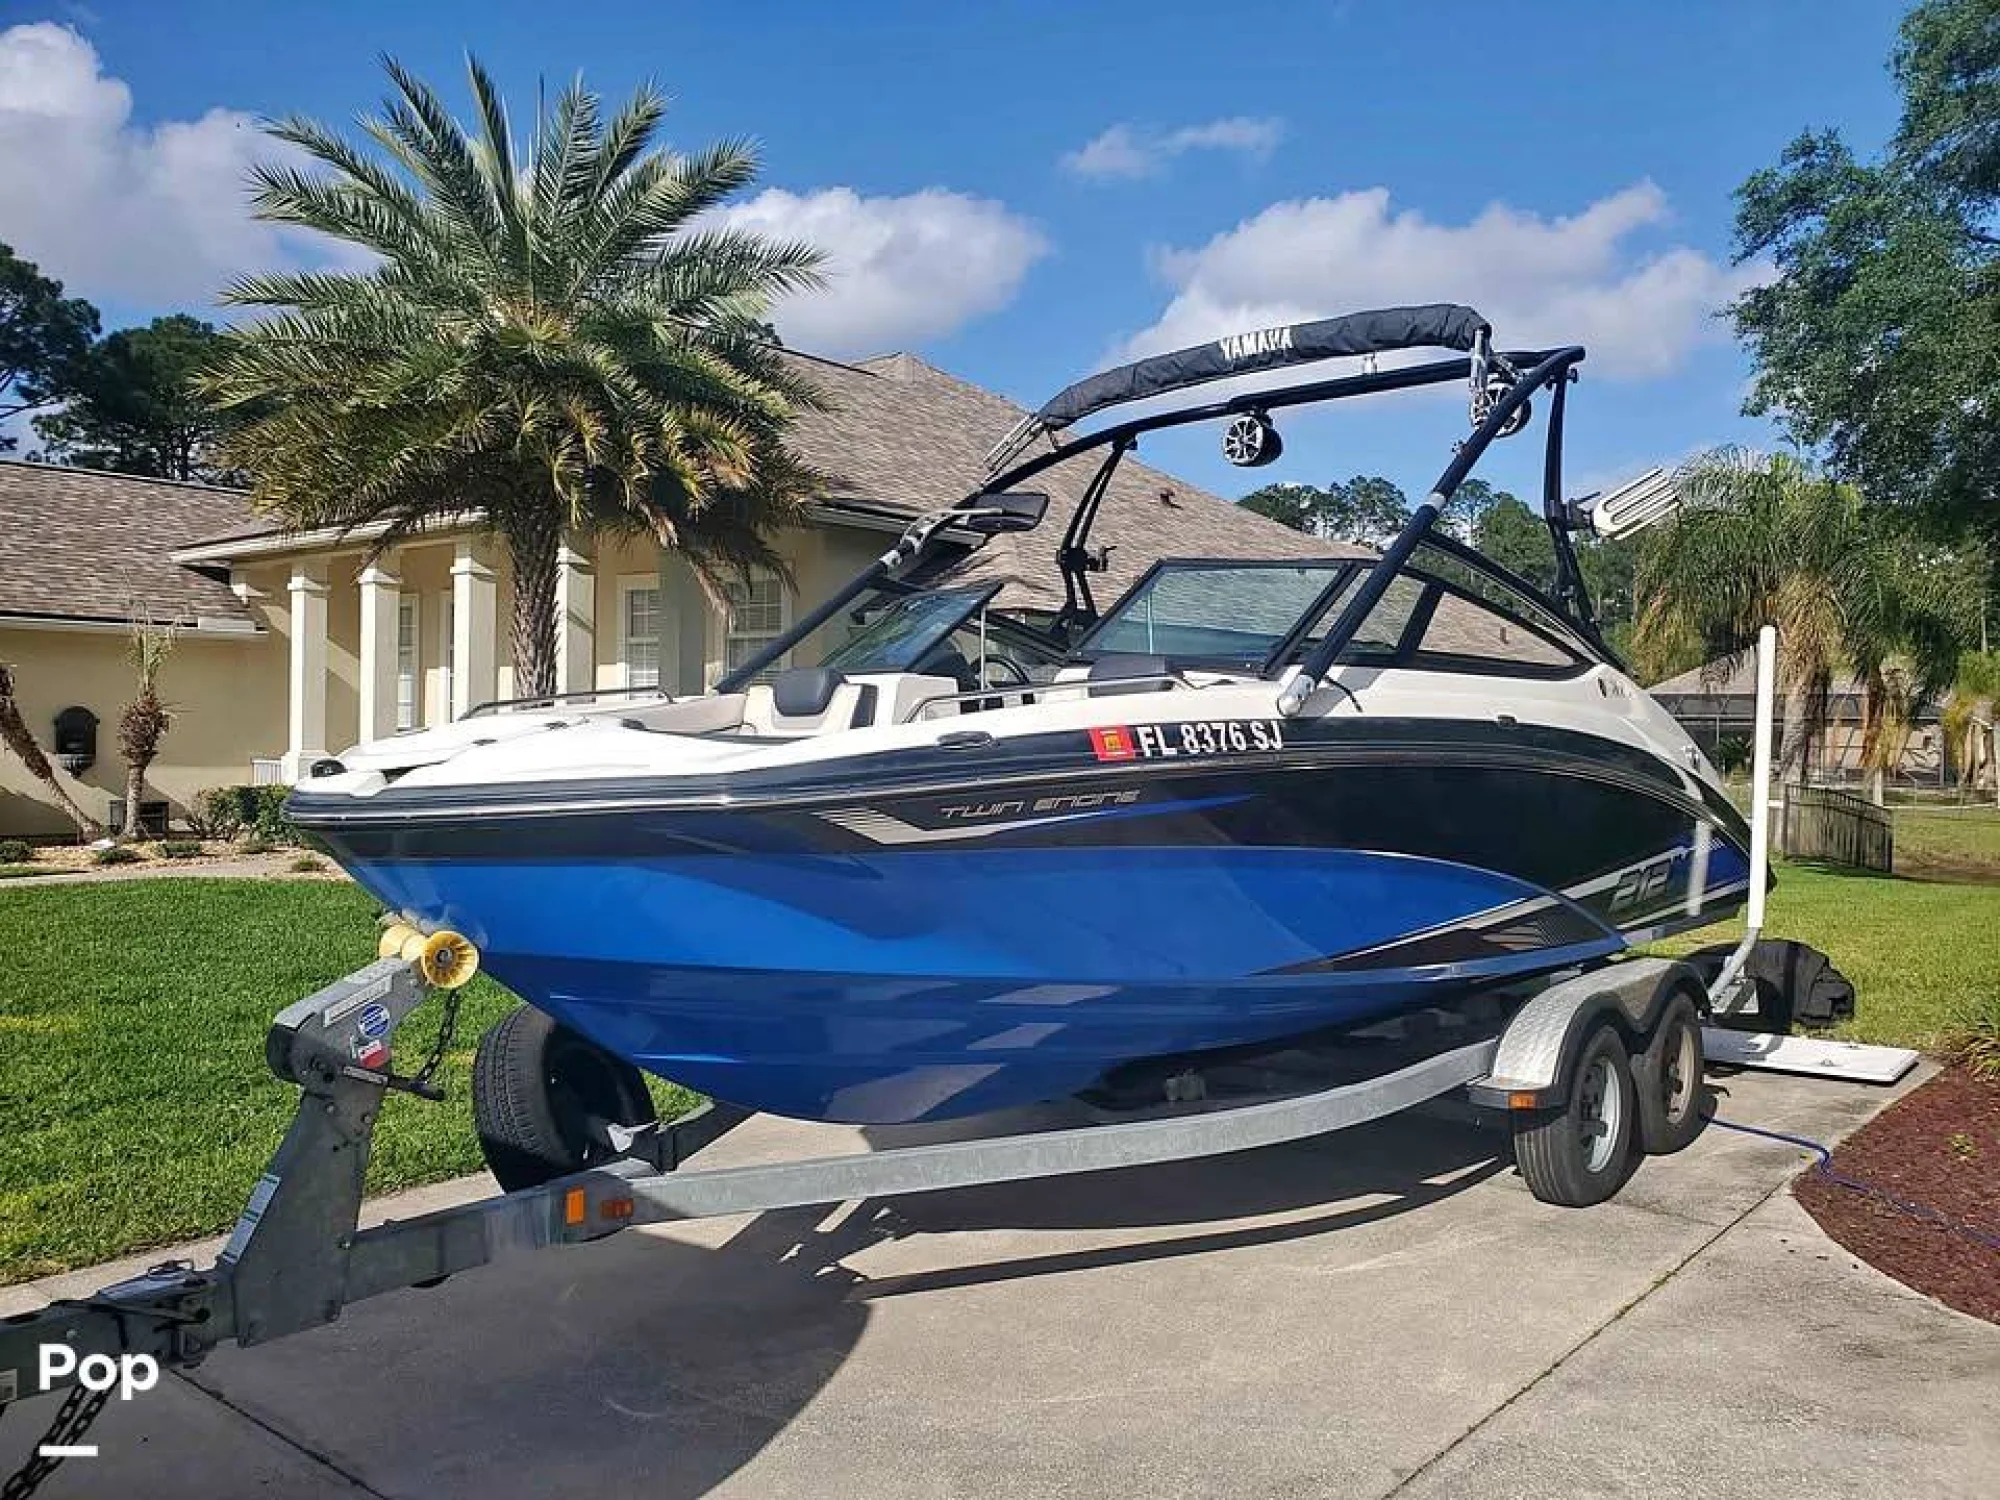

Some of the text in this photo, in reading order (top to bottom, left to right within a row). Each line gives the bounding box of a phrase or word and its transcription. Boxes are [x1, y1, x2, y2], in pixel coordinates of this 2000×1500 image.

[1220, 327, 1293, 360] YAMAHA
[1137, 726, 1177, 757] FL
[1180, 722, 1246, 755] 8376
[1250, 720, 1284, 750] SJ
[940, 801, 1024, 817] TWIN
